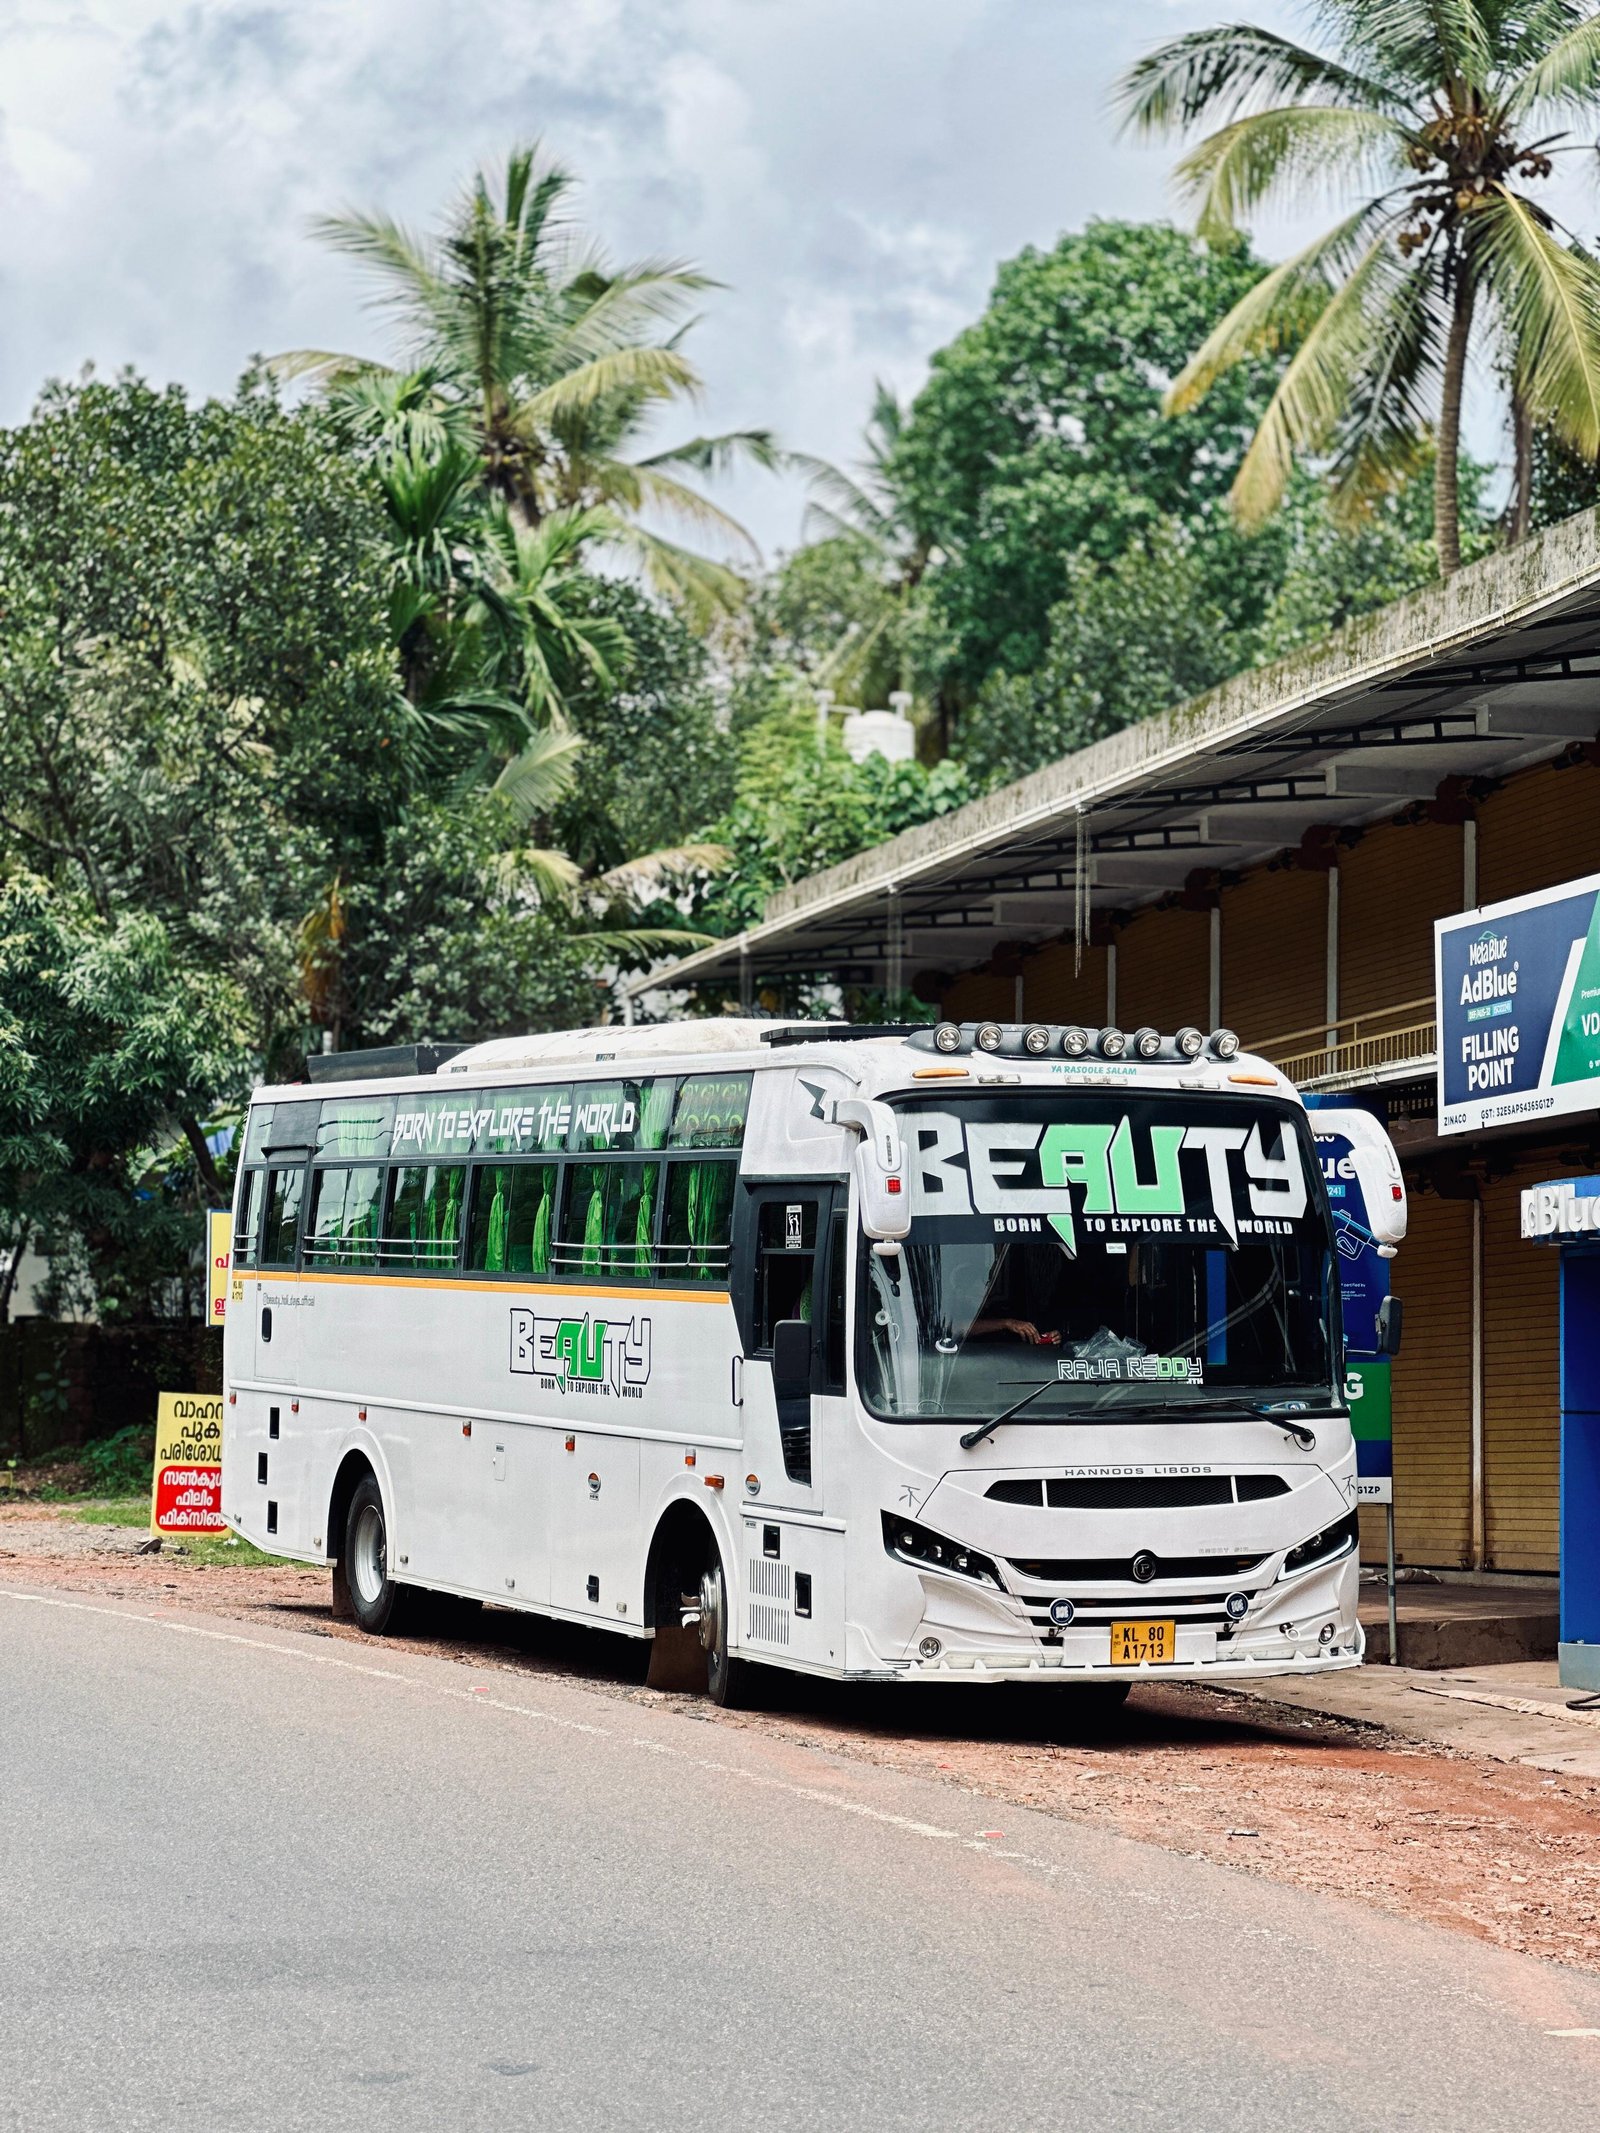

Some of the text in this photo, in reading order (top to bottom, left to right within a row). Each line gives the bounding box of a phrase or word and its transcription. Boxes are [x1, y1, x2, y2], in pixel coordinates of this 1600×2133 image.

[1462, 1026, 1519, 1063] FILLING
[1051, 1065, 1137, 1075] YA RASOOLE SALAM
[1468, 1057, 1514, 1091] POINT
[390, 1096, 636, 1157] BORN TO EXPLORE THE WORLD
[1444, 1114, 1467, 1126] ZINACO
[1481, 1108, 1495, 1119] GST:
[897, 1112, 1309, 1258] BEAUTY
[993, 1218, 1294, 1235] BORN TO EXPLORE THE WORLD
[510, 1308, 651, 1398] BEAUTY
[1057, 1356, 1203, 1380] RAJA REDDY
[541, 1378, 643, 1399] BORN TO EXPLORE THE WORLD
[1065, 1466, 1213, 1477] HANNOOS LIBOOS
[1123, 1626, 1165, 1642] KL 80
[1123, 1643, 1165, 1660] A1713
